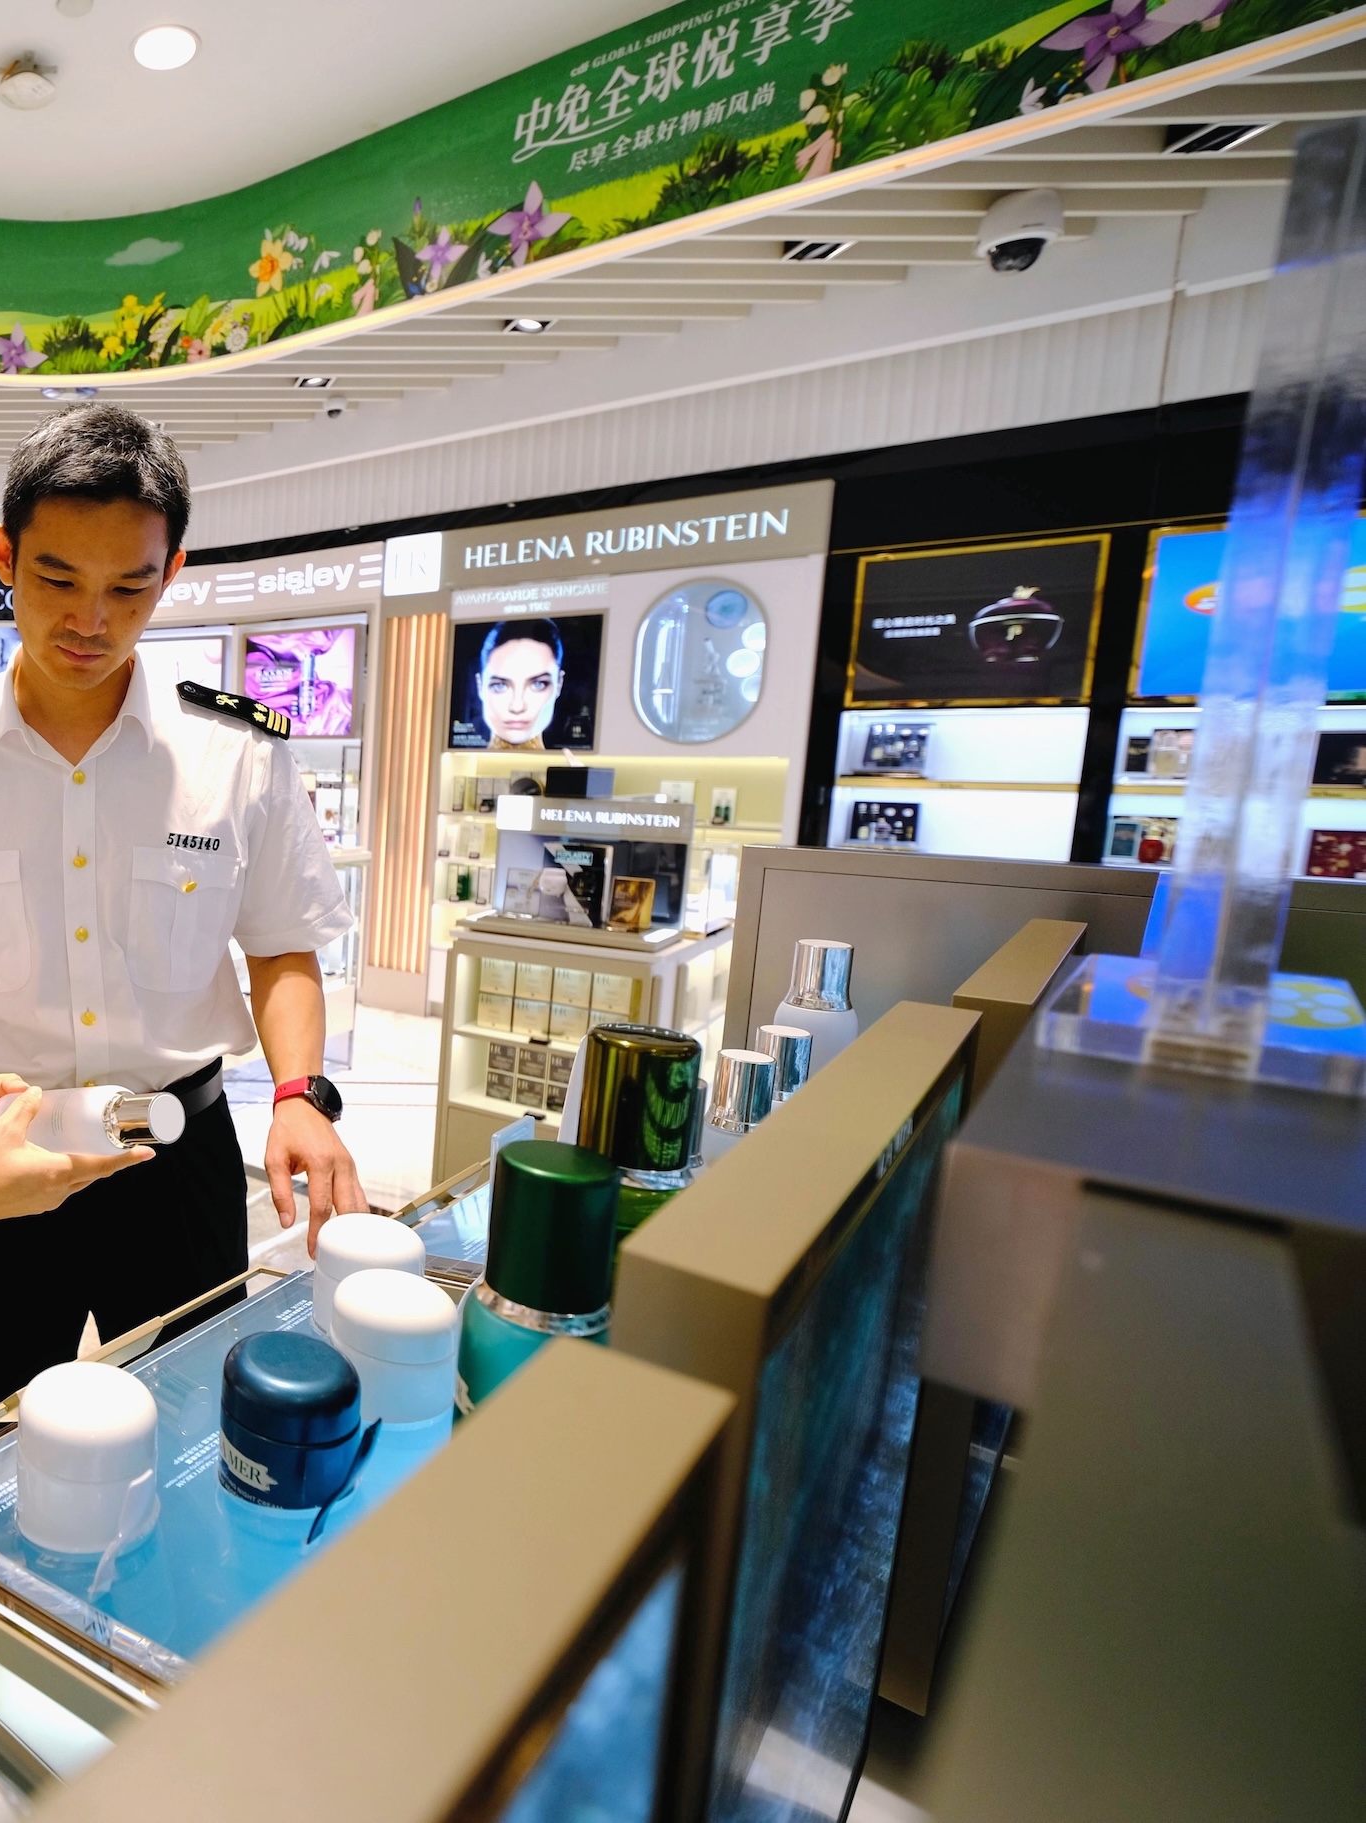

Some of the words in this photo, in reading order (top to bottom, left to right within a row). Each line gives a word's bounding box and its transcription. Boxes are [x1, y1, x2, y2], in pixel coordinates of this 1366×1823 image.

[592, 41, 641, 68] GLOBAL
[644, 10, 714, 49] SHOPPING
[566, 81, 776, 174] 尽享全球好物新风尚
[464, 535, 575, 570] HELENA
[584, 508, 790, 556] RUBINSTEIN
[258, 563, 354, 593] sisley
[540, 808, 592, 823] HELENA
[595, 811, 680, 828] RUBINSTEIN
[166, 832, 220, 851] 5145140
[229, 1449, 263, 1486] MER
[237, 1487, 256, 1503] NIGHT
